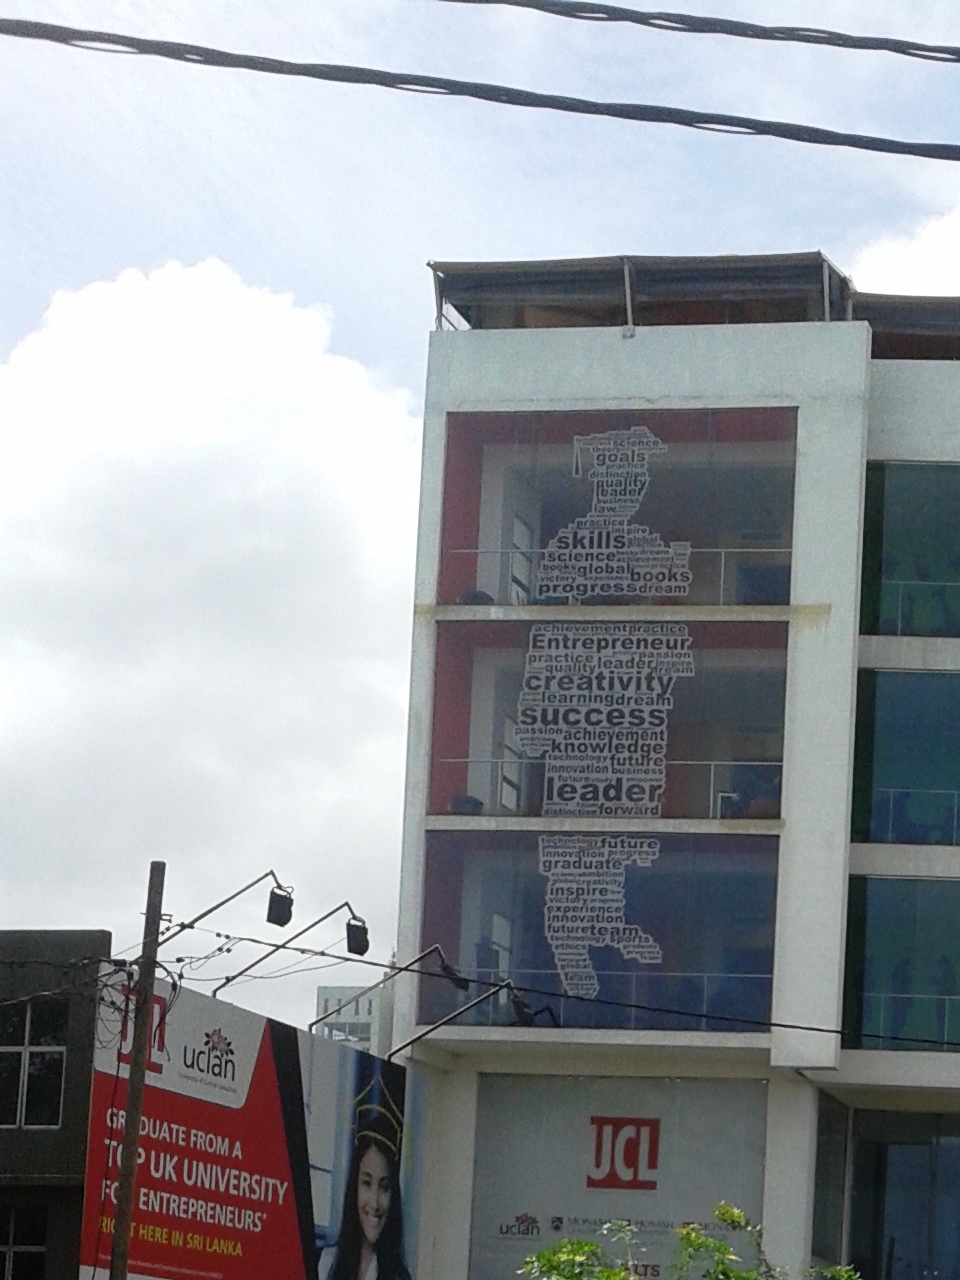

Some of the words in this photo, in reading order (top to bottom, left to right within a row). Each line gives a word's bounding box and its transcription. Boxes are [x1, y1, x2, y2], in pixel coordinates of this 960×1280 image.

[596, 449, 646, 467] goals
[597, 476, 647, 493] quality
[594, 504, 616, 513] law
[557, 530, 626, 550] skills
[547, 550, 616, 562] science
[577, 562, 630, 577] global
[630, 564, 691, 583] books
[538, 583, 638, 598] progress
[639, 585, 687, 594] dream
[534, 623, 628, 633] achievement
[629, 623, 686, 635] practice
[532, 633, 691, 653] Entrepreneur
[529, 651, 594, 664] practice
[598, 656, 655, 669] leader
[545, 662, 597, 676] quality
[525, 671, 675, 697] creativity
[542, 691, 616, 707] learning
[616, 691, 672, 706] dream
[520, 708, 666, 727] success
[515, 727, 563, 736] passion
[563, 728, 665, 742] achievement
[551, 739, 664, 756] knowledge
[611, 753, 664, 768] future
[547, 763, 609, 775] innovation
[547, 777, 663, 802] leader
[599, 803, 660, 815] forward
[600, 838, 659, 850] future
[542, 850, 606, 859] innovation
[543, 858, 624, 873] graduate
[549, 884, 610, 898] inspire
[547, 904, 623, 914] experience
[546, 913, 624, 924] innovation
[547, 922, 590, 934] future
[591, 924, 640, 937] team
[183, 1046, 235, 1081] uclan
[105, 1107, 187, 1146] GRDUATE
[190, 1129, 229, 1157] FROM
[232, 1140, 242, 1160] A
[104, 1138, 147, 1172] TP
[150, 1150, 179, 1182] UK
[184, 1159, 288, 1206] UNIVERSITY
[500, 1221, 540, 1235] uclan
[138, 1223, 168, 1245] HERE
[171, 1230, 184, 1247] IN
[187, 1233, 203, 1251] SRI
[206, 1237, 243, 1257] LANKA
